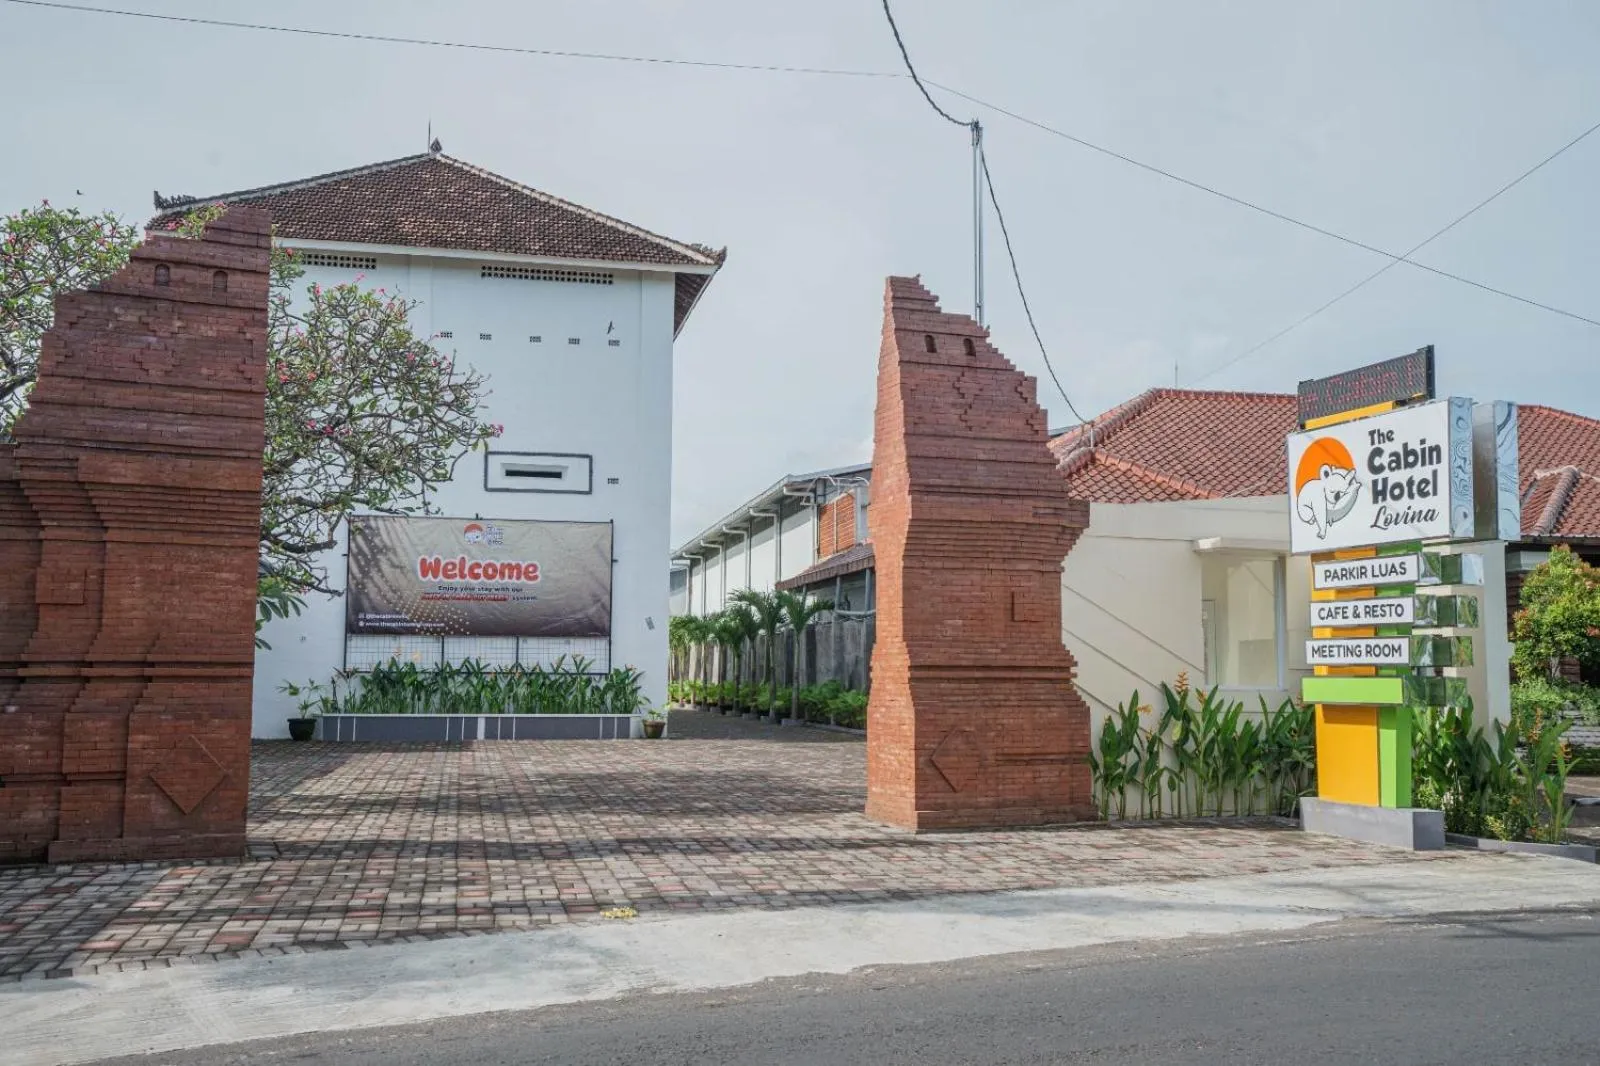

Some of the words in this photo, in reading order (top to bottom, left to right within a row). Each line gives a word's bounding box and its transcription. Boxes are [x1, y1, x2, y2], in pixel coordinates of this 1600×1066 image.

[1368, 428, 1395, 447] The
[1367, 438, 1442, 475] Cabin
[1371, 469, 1438, 505] Hotel
[1370, 505, 1440, 530] Lovina
[419, 556, 540, 582] Welcome
[1324, 565, 1368, 583] PARKIR
[1371, 561, 1407, 578] LUAS
[1317, 605, 1349, 620] CAFE
[1352, 605, 1361, 619] &
[1364, 603, 1404, 619] RESTO
[1311, 644, 1362, 658] MEETING
[1365, 643, 1402, 658] ROOM
